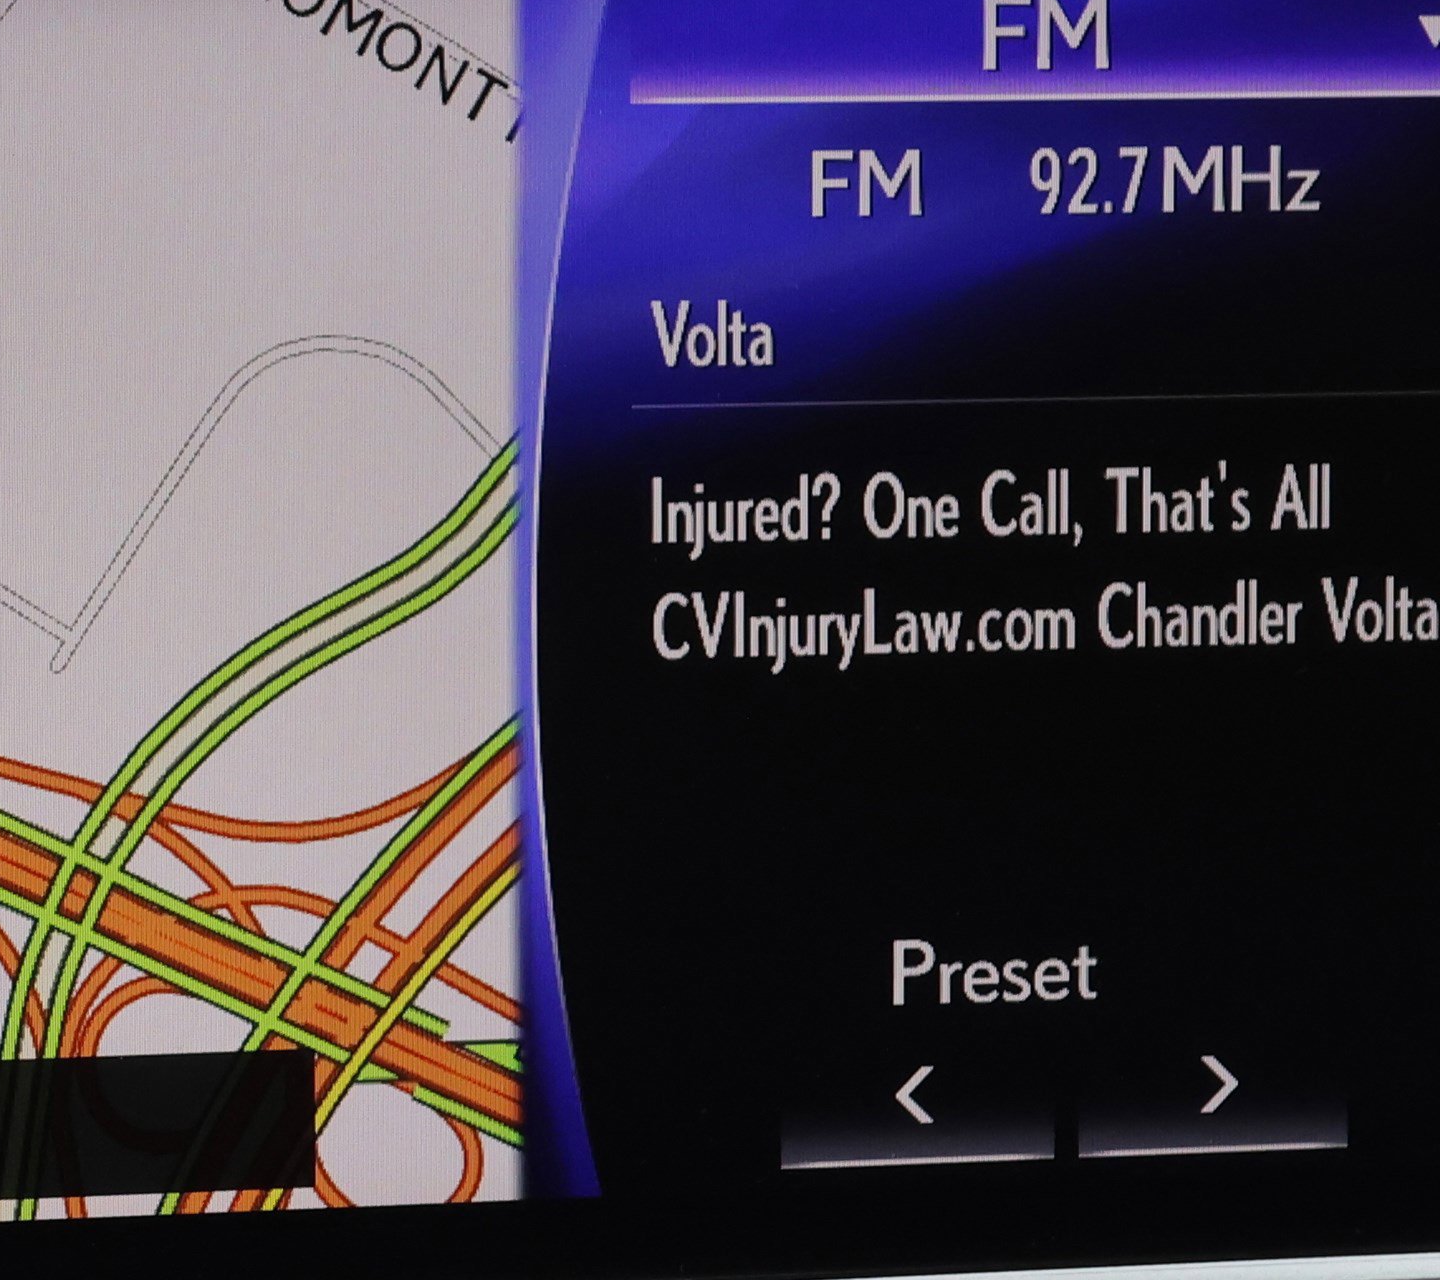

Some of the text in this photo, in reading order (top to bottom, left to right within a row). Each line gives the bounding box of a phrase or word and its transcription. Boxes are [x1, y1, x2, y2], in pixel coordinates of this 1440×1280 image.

[810, 149, 922, 217] FM
[650, 298, 775, 368] Volta
[650, 459, 1332, 560] Injured? One Call, That's All
[651, 576, 1440, 674] CVInjuryLaw.com Chandler Volta
[891, 939, 1098, 1006] Preset
